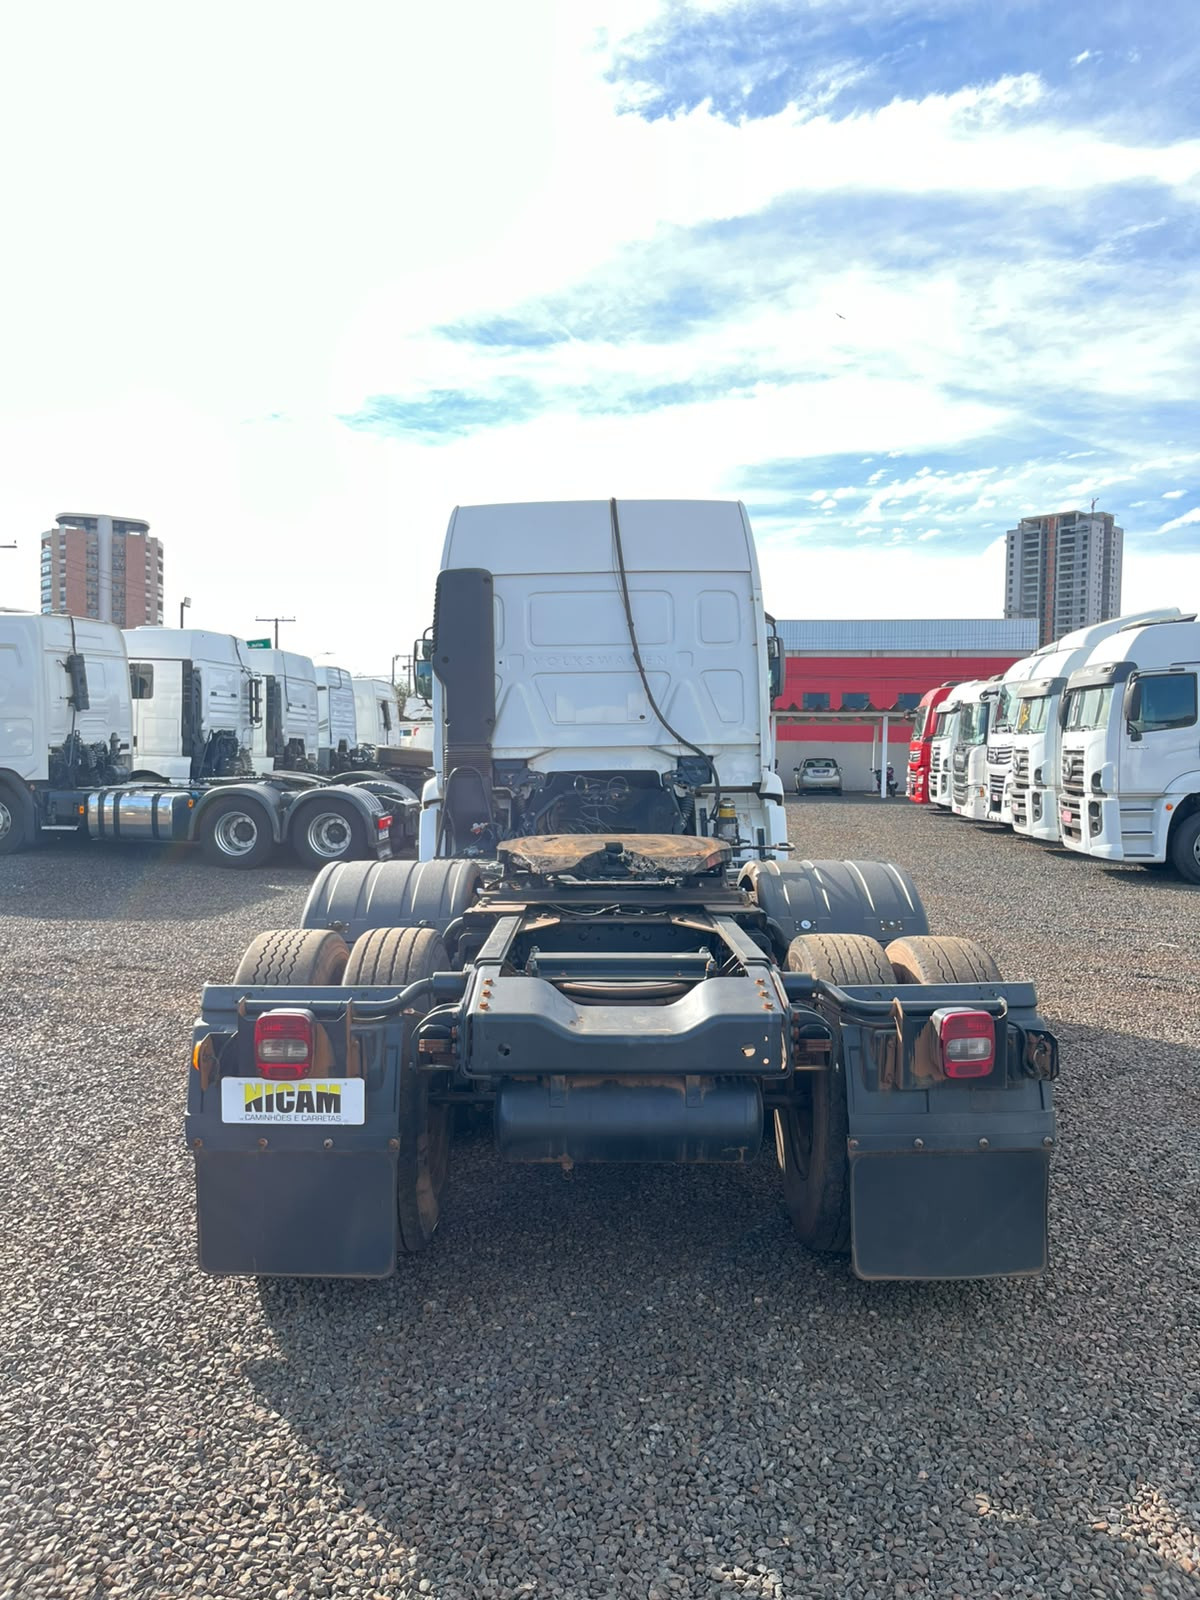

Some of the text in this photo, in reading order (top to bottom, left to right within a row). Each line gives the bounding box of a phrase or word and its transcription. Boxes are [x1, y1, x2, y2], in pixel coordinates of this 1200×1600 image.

[244, 1083, 341, 1113] NICAM
[244, 1113, 292, 1121] CAMINHÕES
[301, 1114, 342, 1122] CARRETAS
